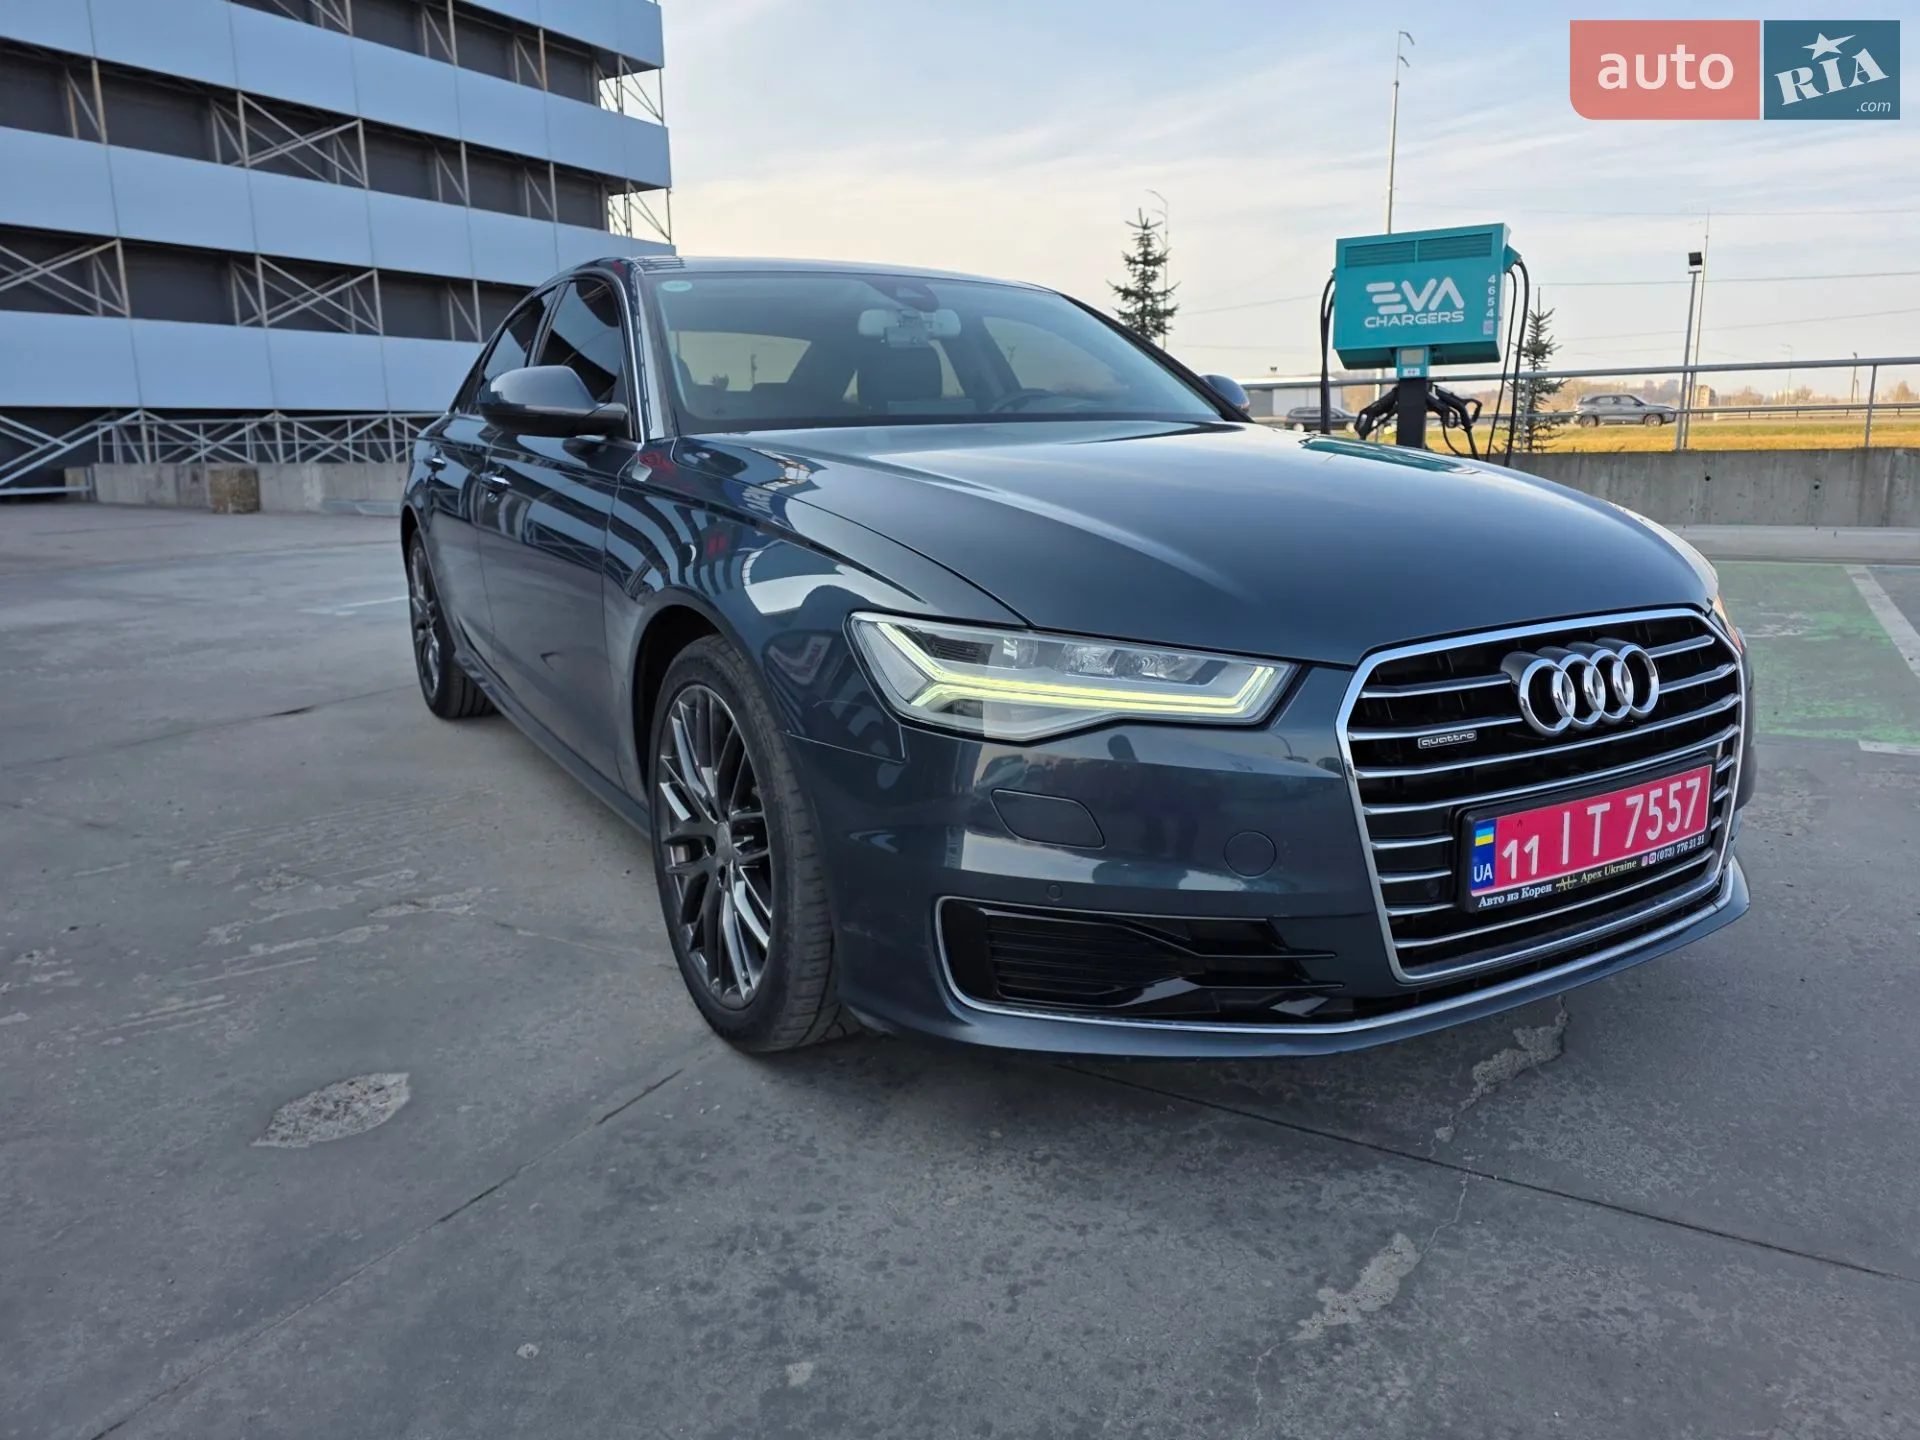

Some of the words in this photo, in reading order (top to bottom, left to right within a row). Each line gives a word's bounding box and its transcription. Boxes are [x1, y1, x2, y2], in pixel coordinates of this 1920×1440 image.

[1365, 276, 1465, 315] EVA
[1364, 311, 1465, 329] CHARGERS
[1421, 732, 1475, 747] quattro
[1502, 834, 1540, 879] 11
[1625, 776, 1701, 849] 7557
[1656, 846, 1675, 861] (073)
[1473, 863, 1493, 882] UA
[1580, 870, 1603, 884] Apex
[1604, 860, 1637, 876] Ukraine
[1478, 896, 1504, 907] Авто
[1507, 891, 1519, 902] из
